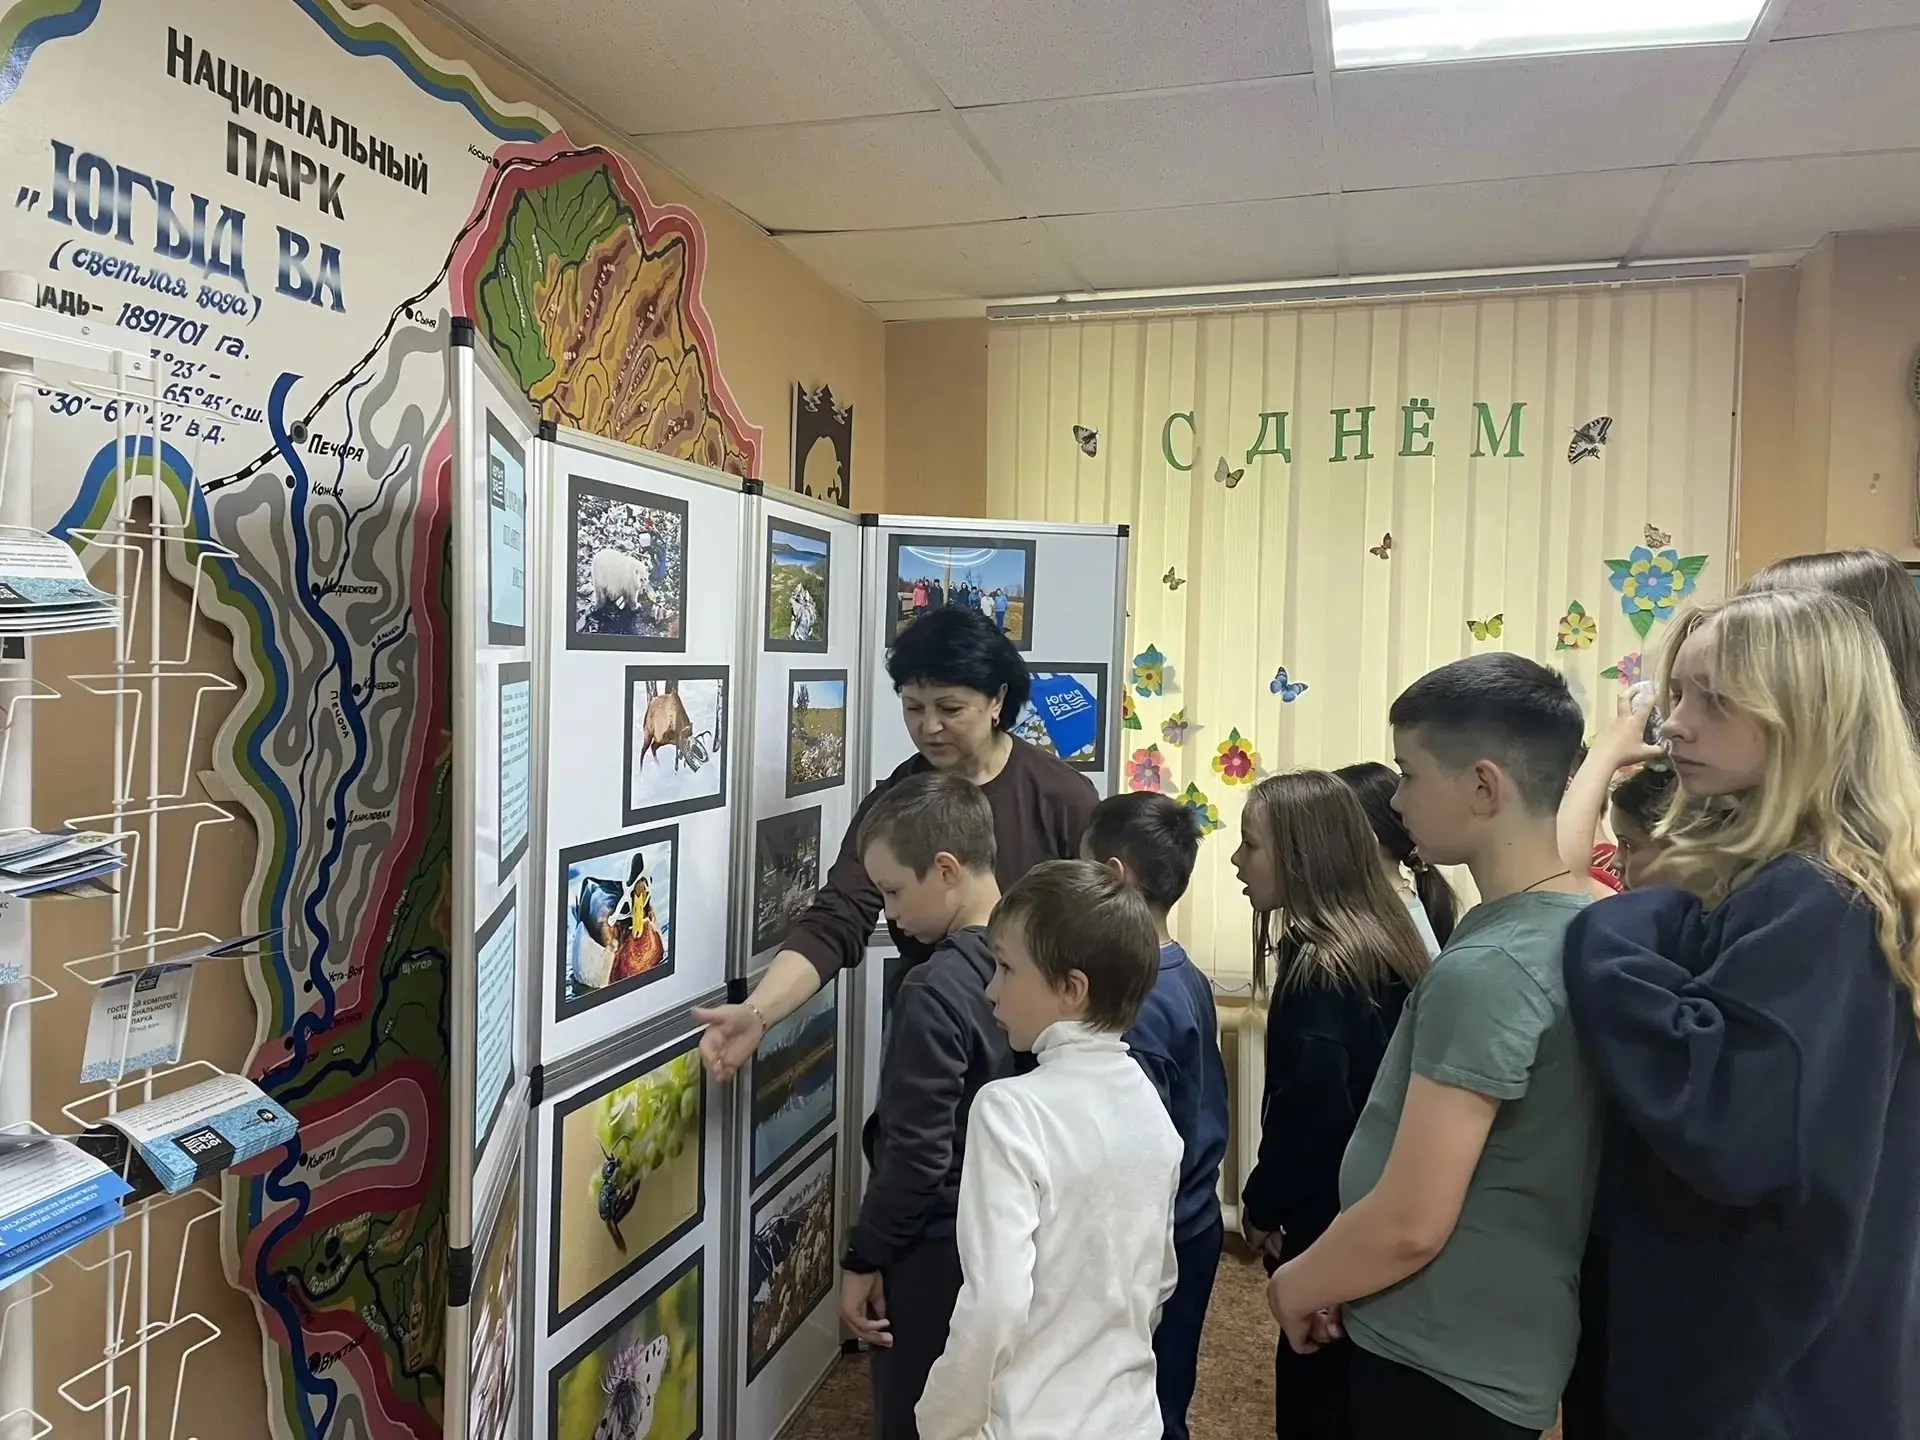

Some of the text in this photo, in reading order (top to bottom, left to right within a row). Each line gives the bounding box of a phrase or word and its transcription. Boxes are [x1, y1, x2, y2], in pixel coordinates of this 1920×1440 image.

[167, 26, 429, 195] НАЦИОНАЛЬНЫЙ
[226, 120, 346, 221] ПАРК
[49, 239, 188, 299] (светлая
[116, 303, 209, 346] 1891701
[215, 334, 250, 360] га.
[1162, 411, 1200, 472] С
[107, 997, 142, 1015] ГОСТЕОЙ
[112, 1002, 172, 1021] НАЦОНАЛЬНОГО
